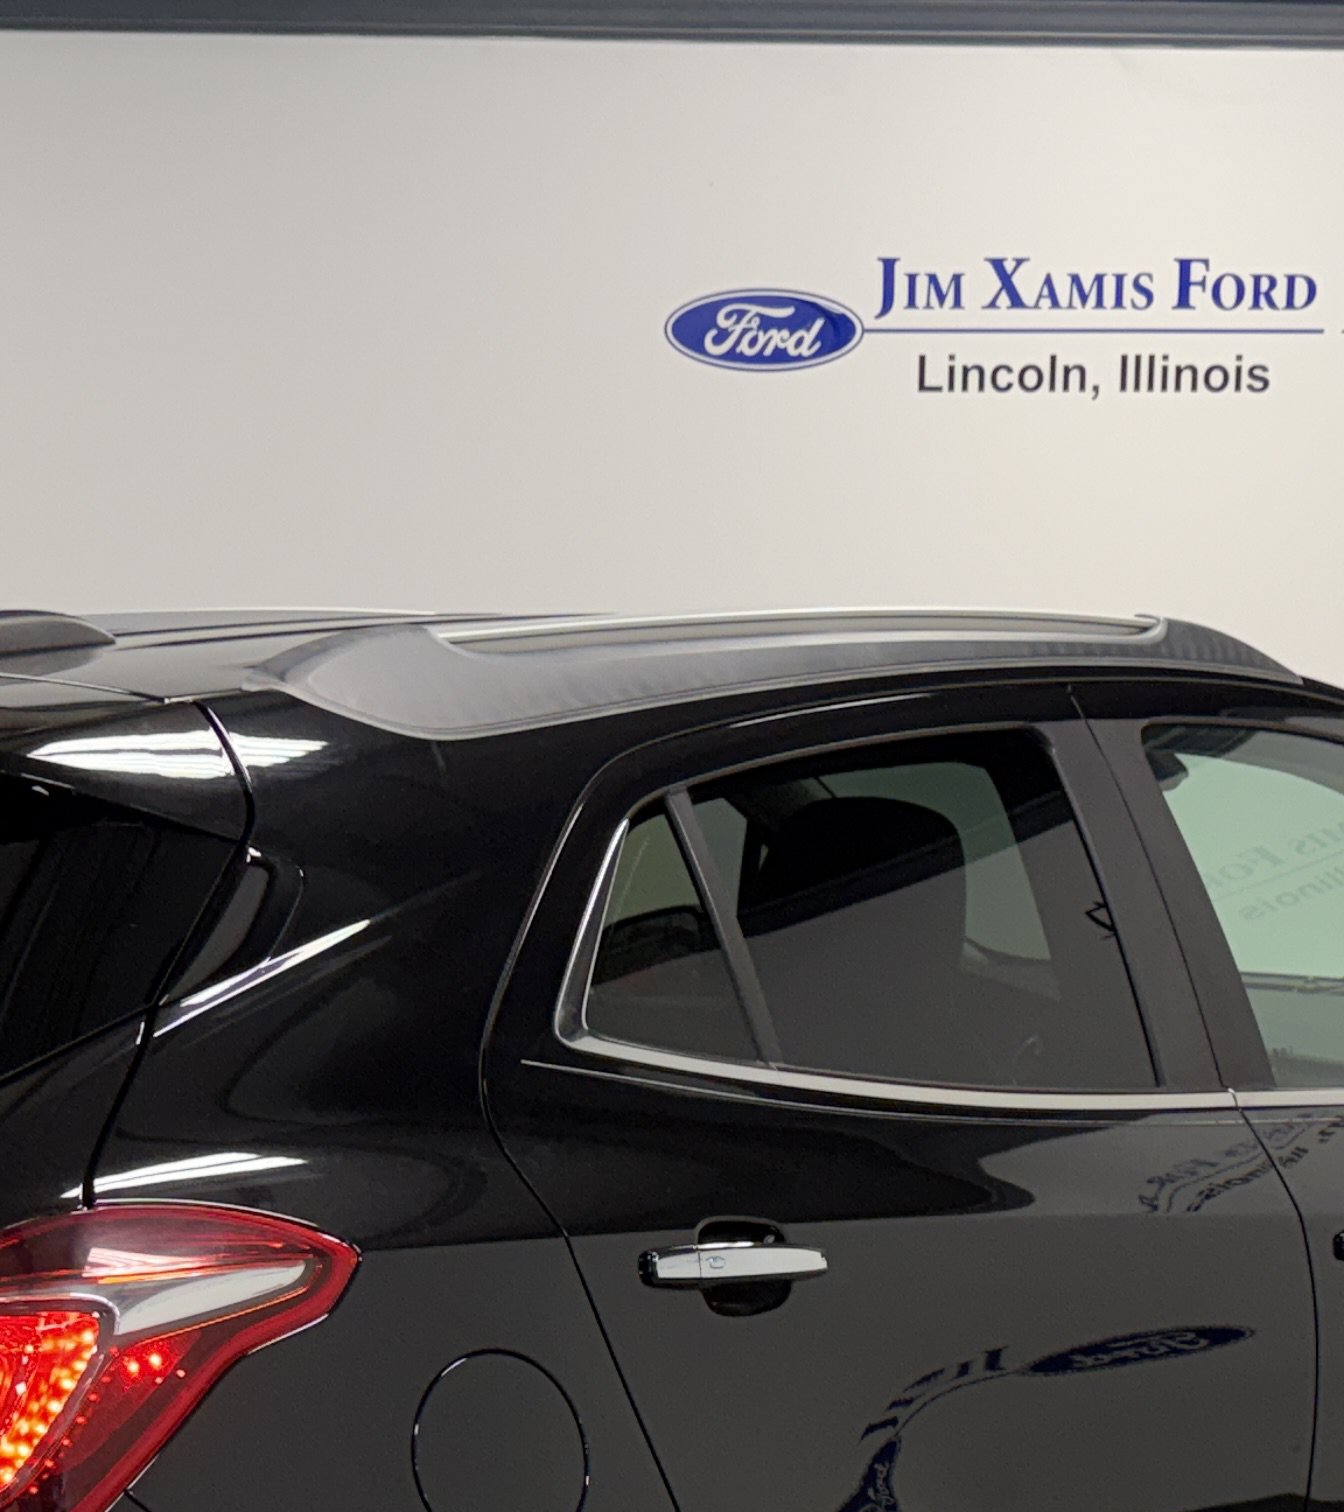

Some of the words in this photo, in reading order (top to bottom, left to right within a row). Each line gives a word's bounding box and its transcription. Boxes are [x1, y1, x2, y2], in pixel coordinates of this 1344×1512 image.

[874, 257, 966, 320] JIM
[981, 257, 1154, 311] XAMIS
[1172, 257, 1317, 311] FORD
[704, 302, 822, 360] Ford
[918, 354, 1100, 399] Lincoln,
[1119, 354, 1271, 394] Illinois
